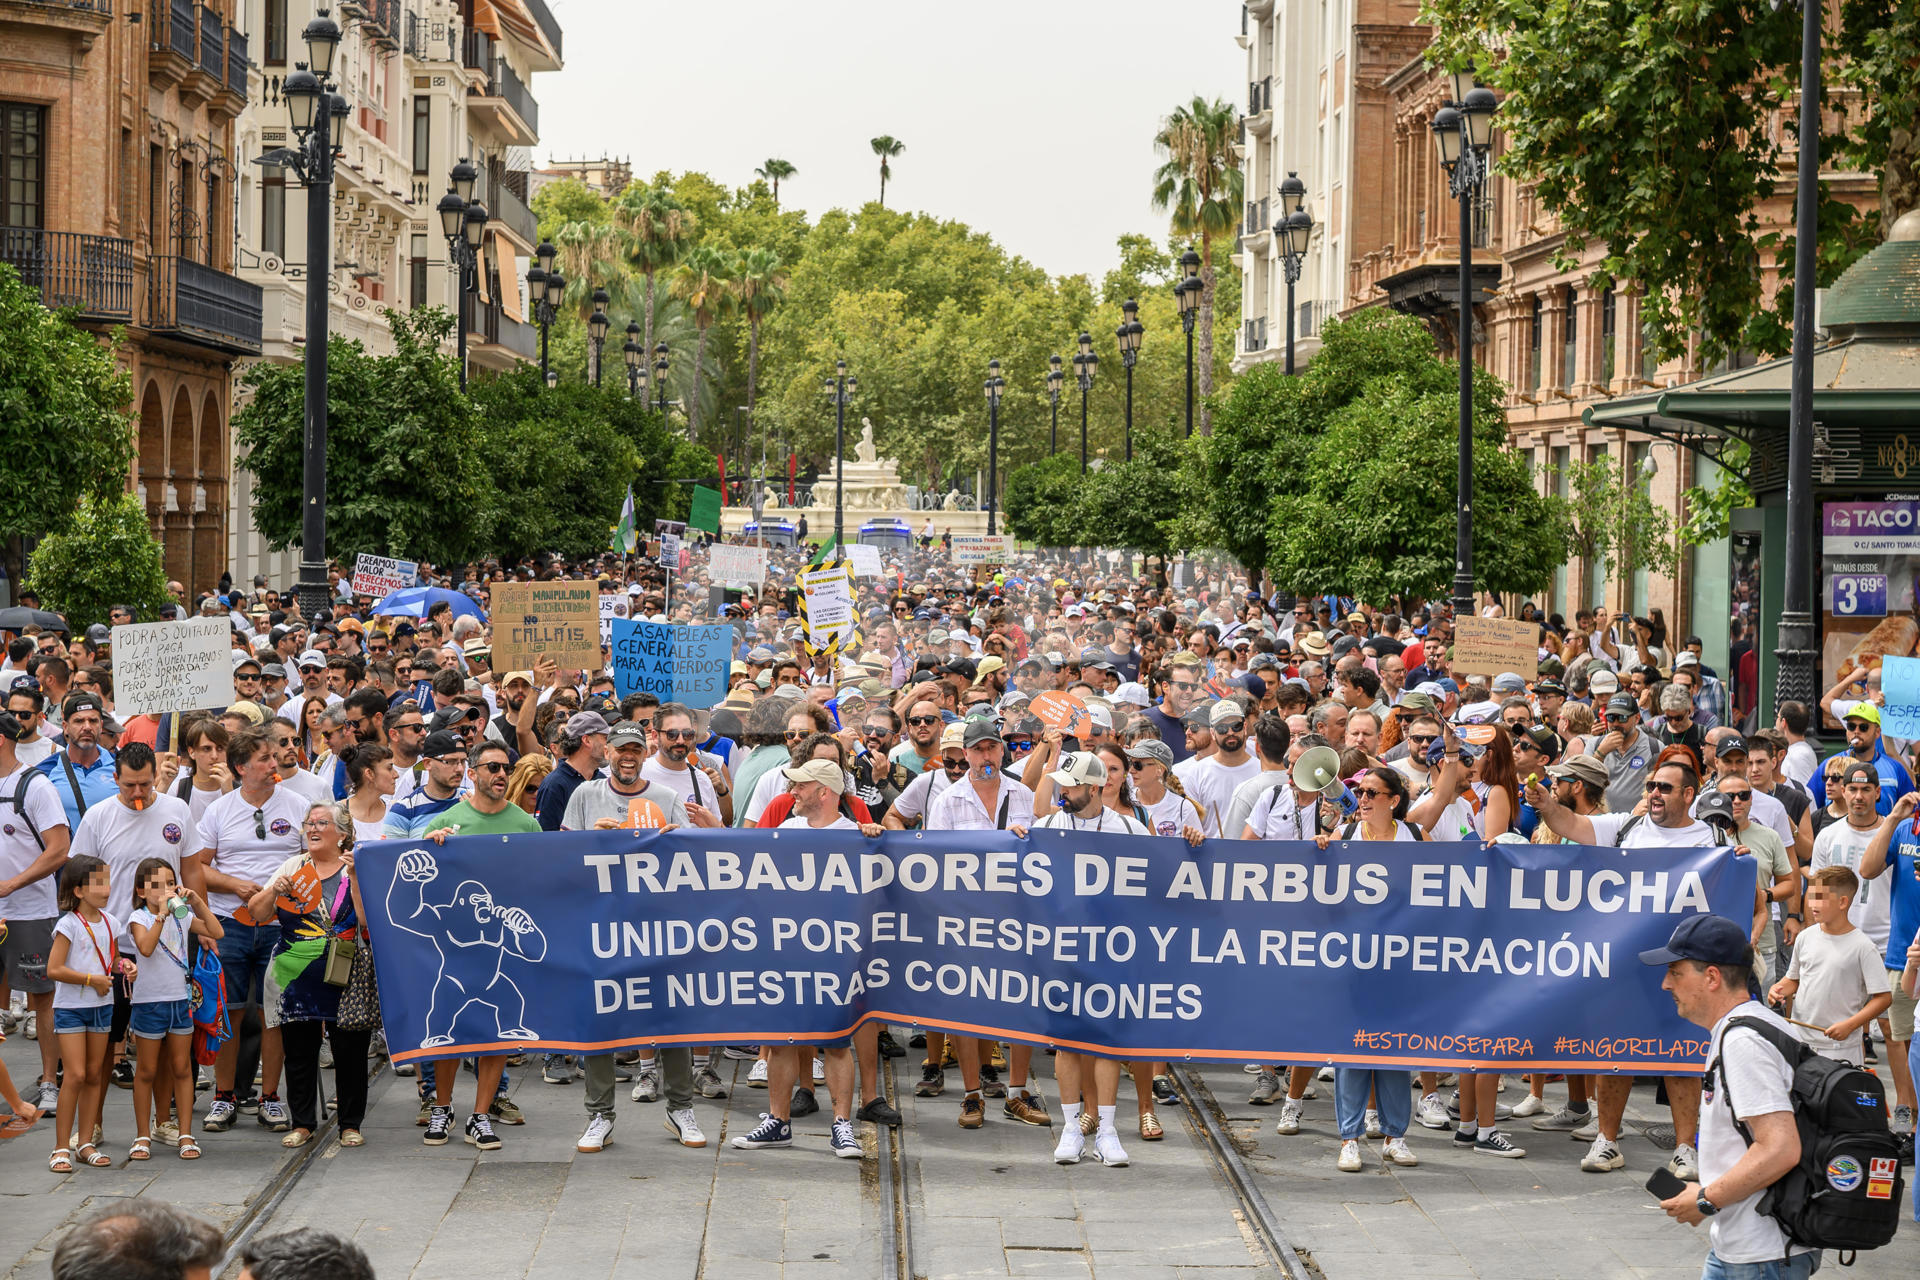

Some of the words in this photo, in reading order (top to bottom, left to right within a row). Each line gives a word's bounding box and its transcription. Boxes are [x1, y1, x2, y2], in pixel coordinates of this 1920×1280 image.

[1853, 509, 1912, 528] TACO
[1871, 540, 1895, 550] SANTO
[357, 563, 384, 576] VALOR
[358, 555, 396, 569] CREAMOS
[1833, 562, 1856, 573] MENÚS
[1858, 563, 1878, 573] DESDE
[353, 582, 388, 596] RESPETO
[355, 572, 402, 589] MERECEMOS
[524, 616, 538, 626] NO
[119, 627, 168, 649] PODRAS
[512, 622, 584, 643] CALLÁIS
[632, 624, 722, 642] ASAMBLEAS
[132, 646, 149, 659] LA
[156, 642, 183, 656] PAGA
[618, 639, 707, 659] GENERALES
[119, 660, 152, 676] PODRAS
[156, 650, 223, 667] AUMENTARNOS
[133, 670, 152, 680] LAS
[155, 663, 209, 677] JORNADAS
[615, 655, 646, 672] PARA
[653, 659, 724, 674] ACUERDOS
[1891, 663, 1914, 680] NO
[122, 680, 147, 693] PERO
[156, 673, 191, 688] JAMAS
[627, 672, 715, 693] LABORALES
[129, 688, 183, 704] ACABARAS
[189, 685, 208, 695] CON
[138, 702, 154, 714] LA
[584, 851, 1054, 897] TRABAJADORES
[1075, 855, 1149, 897] DE
[1166, 861, 1389, 905] AIRBUS
[1410, 865, 1488, 909] EN
[1510, 868, 1710, 914] LUCHA
[592, 916, 758, 959] UNIDOS
[772, 917, 863, 953] POR
[871, 912, 923, 943] EL
[937, 915, 1137, 963] RESPETO
[1149, 926, 1178, 962] Y
[1190, 928, 1247, 965] LA
[1258, 930, 1611, 978] RECUPERACIÓN
[595, 976, 652, 1014] DE
[667, 958, 890, 1008] NUESTRAS
[904, 960, 1203, 1020] CONDICIONES
[1353, 1029, 1534, 1056] #ESTONOSEPARA
